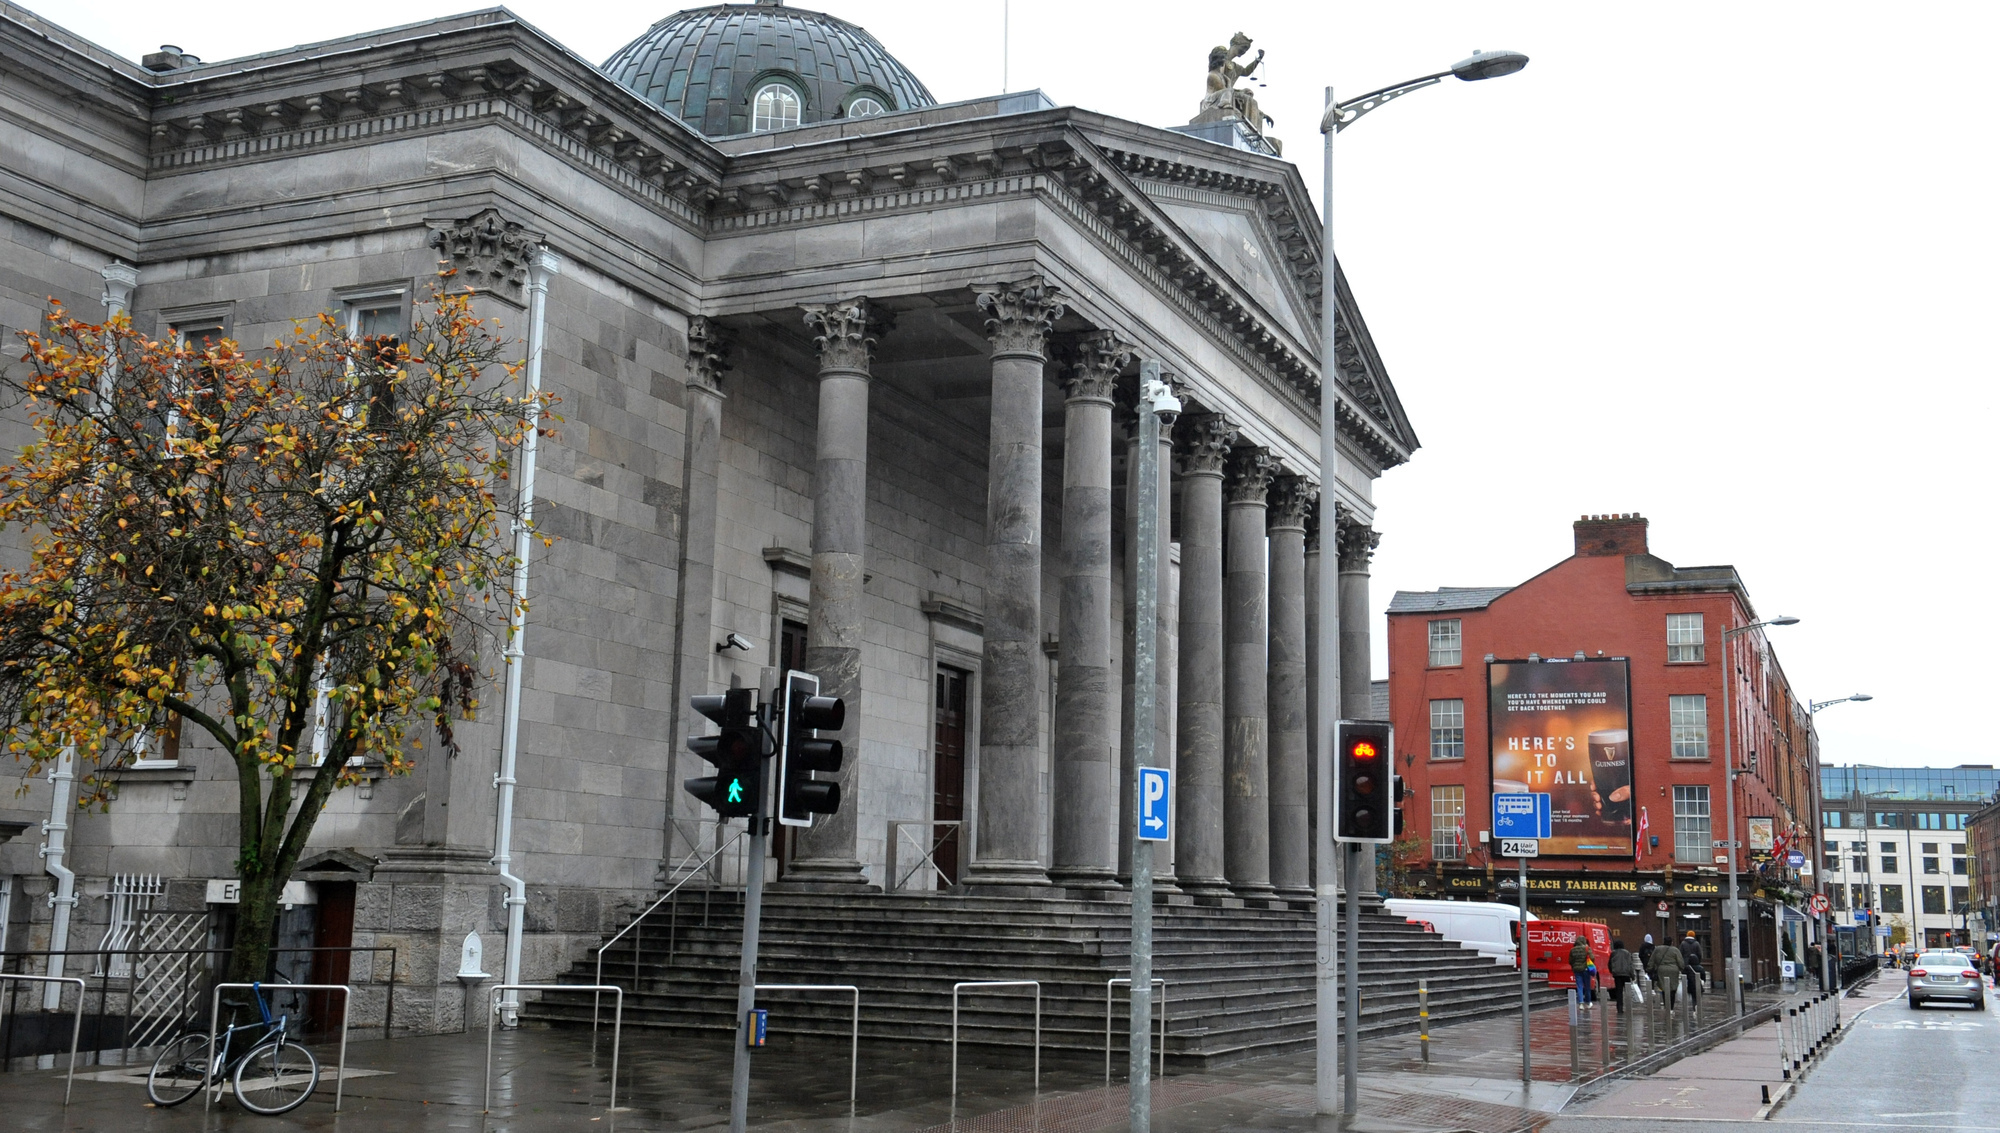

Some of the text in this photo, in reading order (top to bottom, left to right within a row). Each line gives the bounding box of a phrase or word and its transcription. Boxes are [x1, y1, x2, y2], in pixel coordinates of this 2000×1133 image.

[1508, 736, 1575, 751] HERE'S
[1534, 753, 1557, 768] TO
[1527, 770, 1588, 785] IT ALL
[1144, 772, 1164, 818] P
[1503, 842, 1520, 854] 24
[1451, 877, 1482, 888] Ceoil
[1525, 880, 1561, 890] TEACH
[1566, 880, 1637, 890] TABHAIRNE
[1683, 882, 1719, 893] Craic
